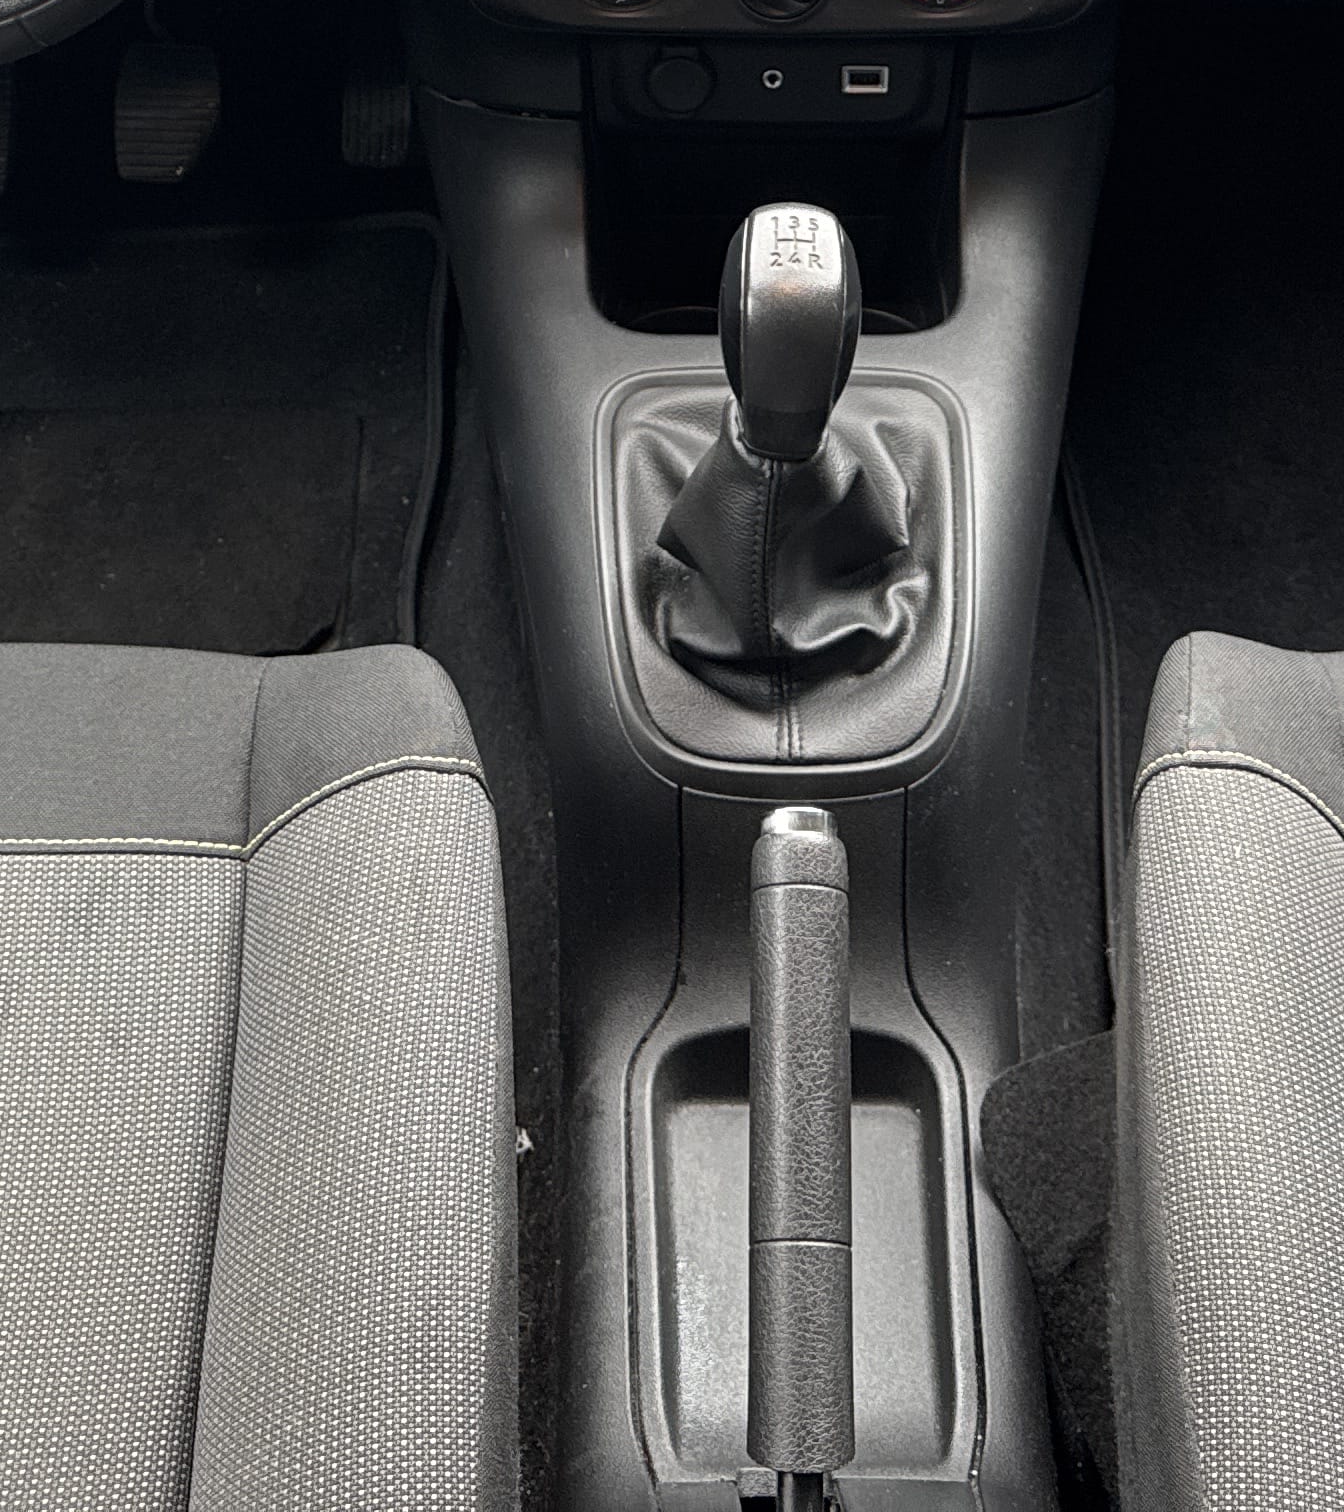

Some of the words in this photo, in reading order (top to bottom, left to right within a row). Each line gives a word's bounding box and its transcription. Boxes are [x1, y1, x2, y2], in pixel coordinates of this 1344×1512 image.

[771, 216, 779, 231] 1
[788, 215, 801, 229] 3
[808, 217, 820, 231] 5
[770, 251, 784, 267] 2
[787, 251, 802, 264] 4
[808, 253, 824, 269] R
